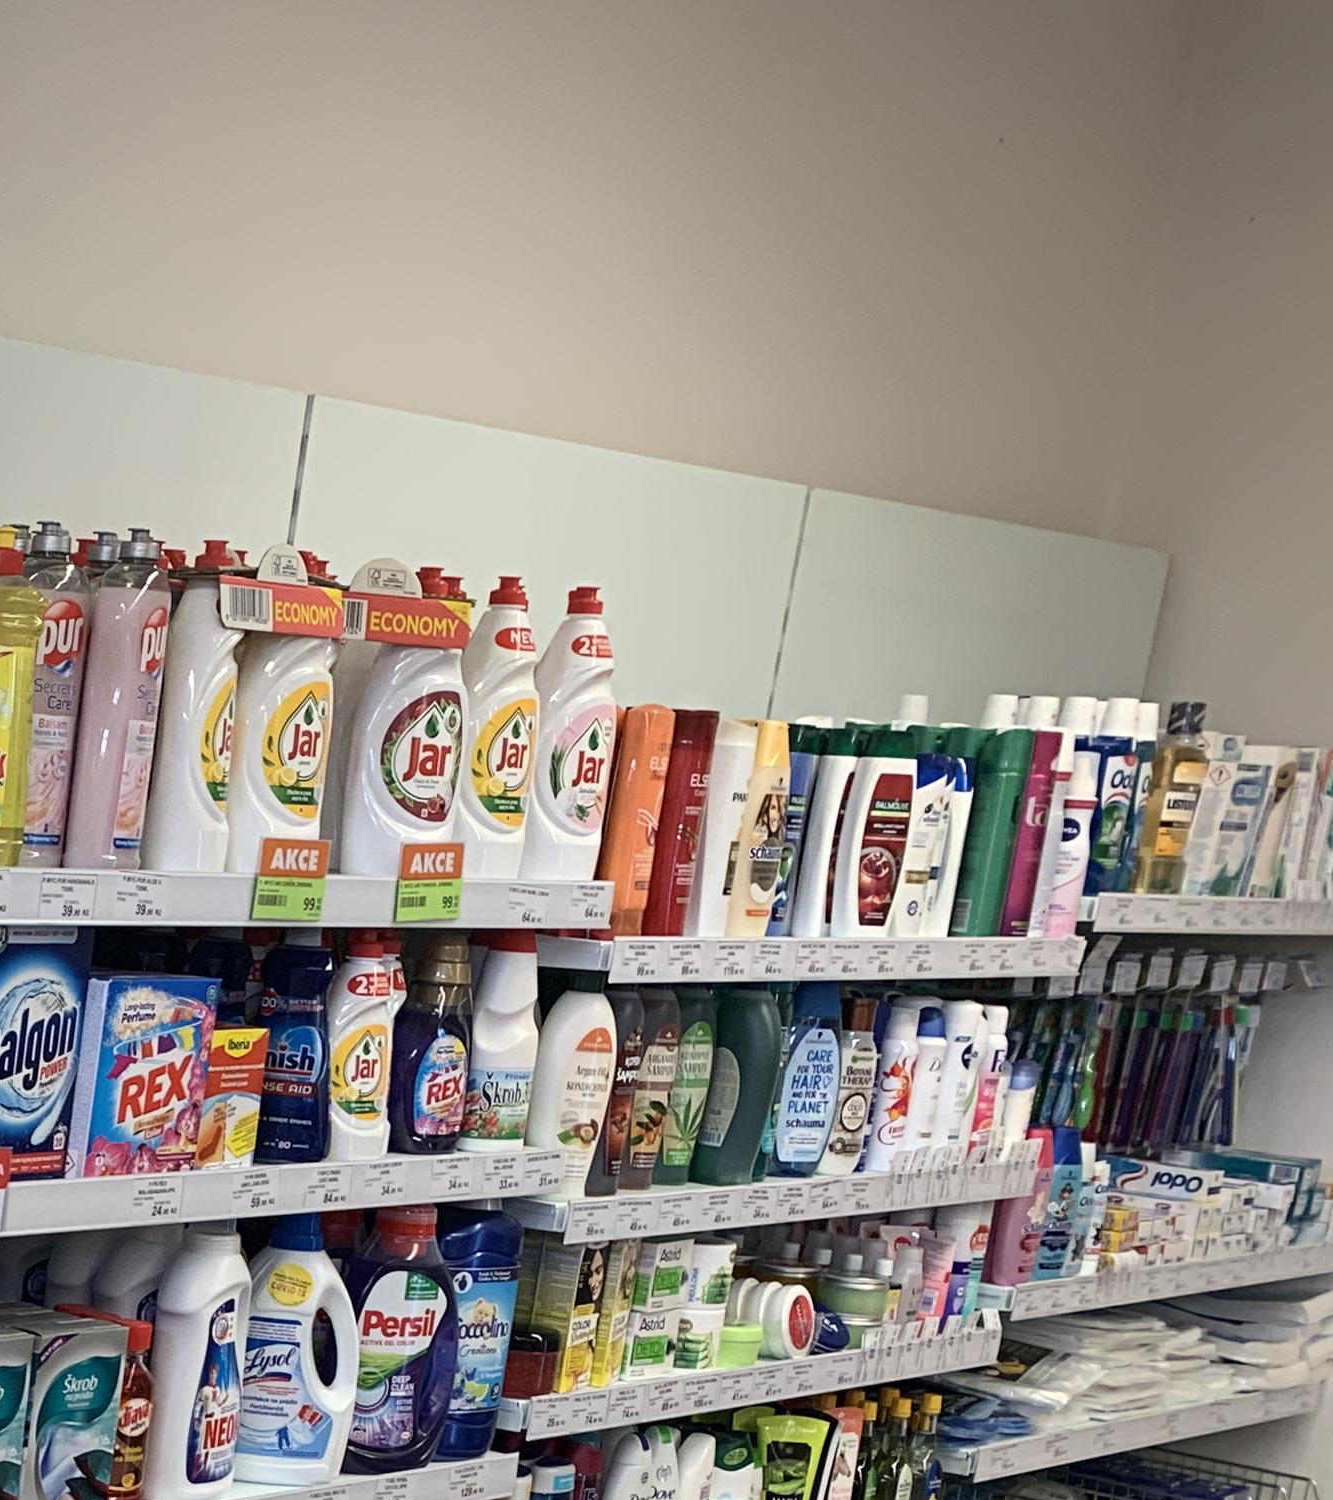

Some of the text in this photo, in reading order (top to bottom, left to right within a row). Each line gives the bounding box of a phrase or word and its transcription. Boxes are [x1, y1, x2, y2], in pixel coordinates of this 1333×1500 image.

[273, 600, 338, 631] ECONOMY
[369, 611, 460, 639] ECONOMY
[37, 615, 85, 664] pur
[287, 727, 322, 762] Jar
[404, 736, 454, 781] Jar
[268, 846, 320, 872] AKCE
[409, 852, 456, 876] AKCE
[117, 1055, 192, 1122] REX
[427, 1074, 462, 1106] REX
[361, 1309, 436, 1340] Persil
